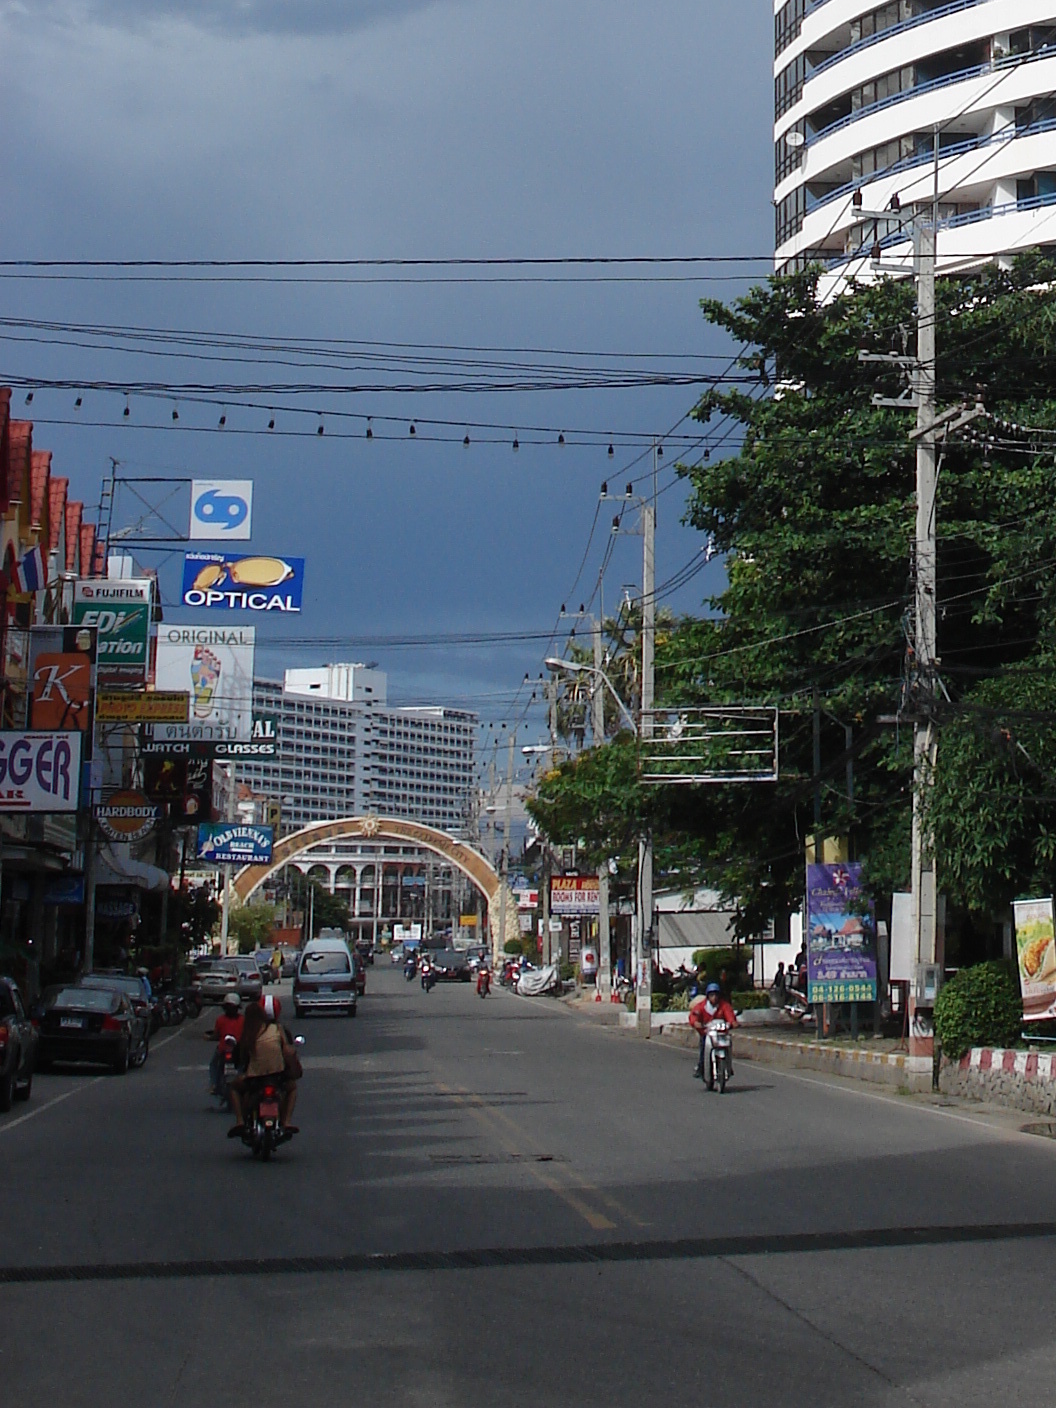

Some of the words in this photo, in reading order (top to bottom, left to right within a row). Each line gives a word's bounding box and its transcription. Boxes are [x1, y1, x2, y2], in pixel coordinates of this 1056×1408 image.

[96, 588, 144, 598] FUJIFILM
[184, 590, 301, 611] OPTICAL
[168, 630, 247, 645] ORIGINAL
[98, 638, 143, 654] ation
[142, 743, 189, 753] WATCH
[215, 744, 275, 754] GLASSES
[96, 806, 158, 817] HARDBODY
[213, 830, 233, 847] OLD
[215, 852, 270, 862] RESTAURANT
[552, 878, 577, 890] PLAZA
[553, 892, 572, 902] ROOMS
[575, 892, 585, 902] FOR
